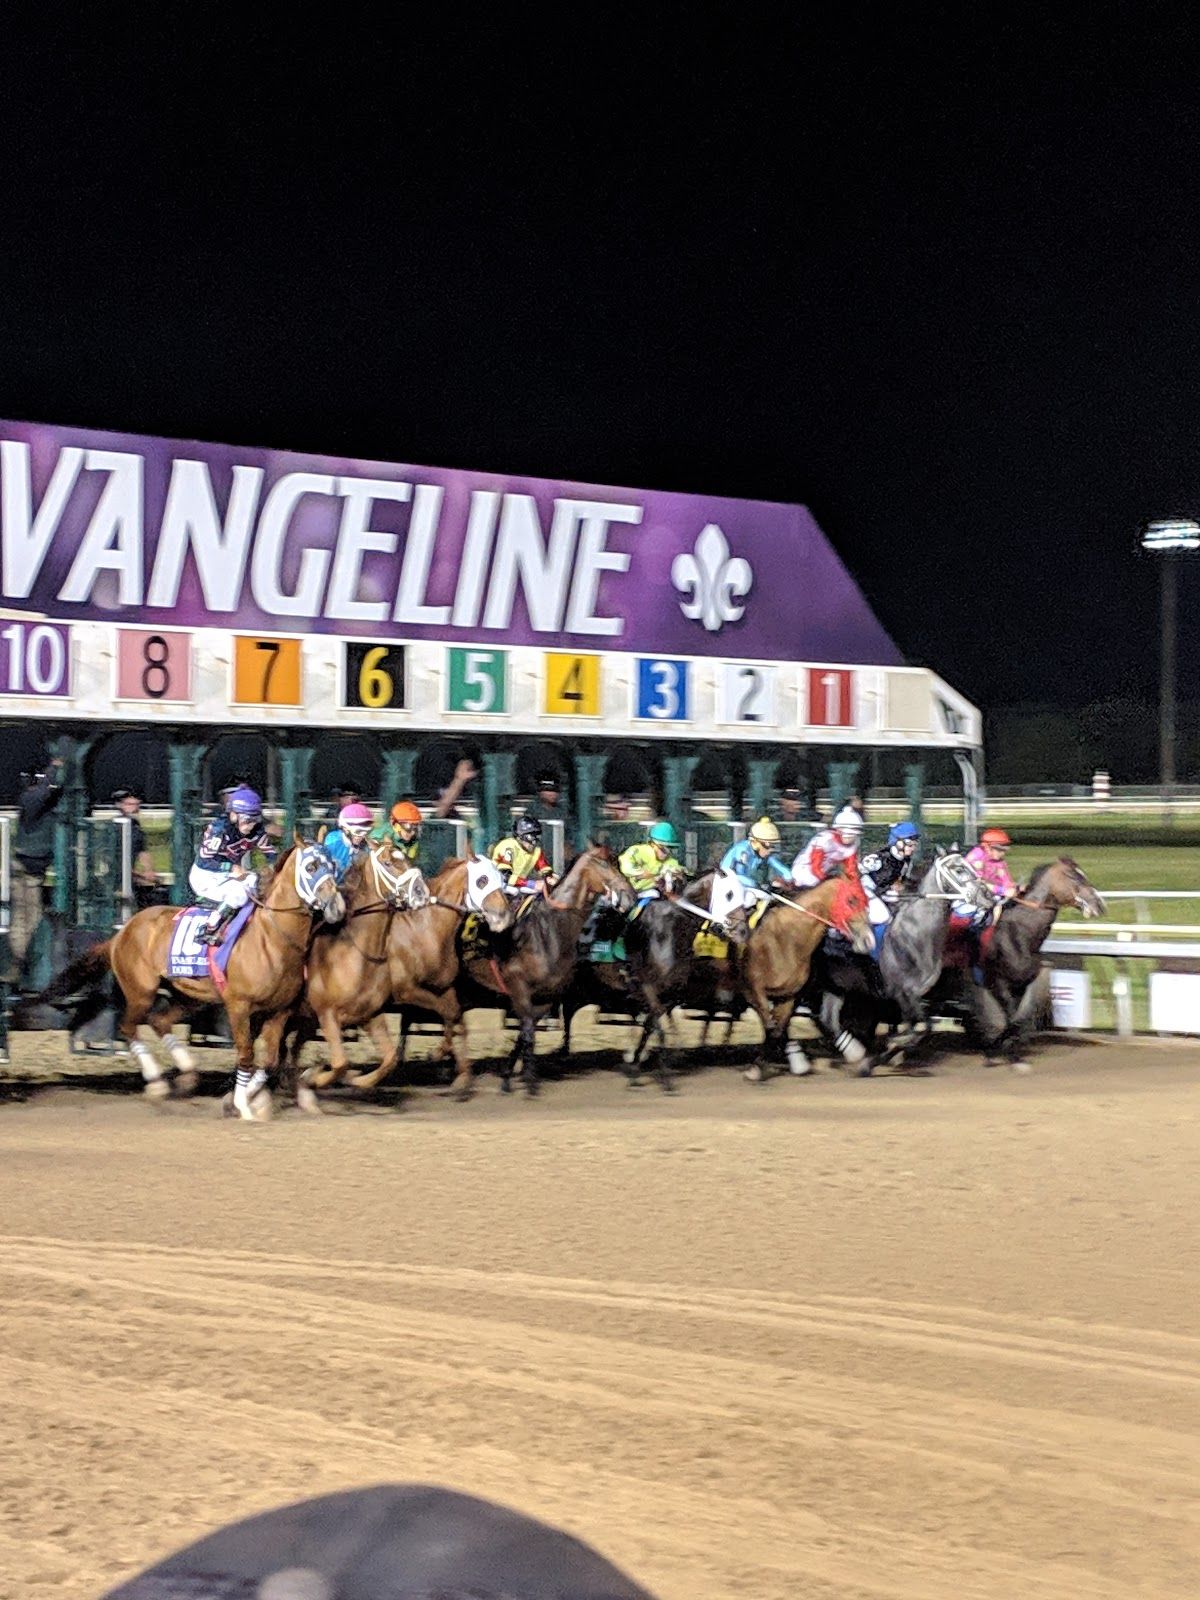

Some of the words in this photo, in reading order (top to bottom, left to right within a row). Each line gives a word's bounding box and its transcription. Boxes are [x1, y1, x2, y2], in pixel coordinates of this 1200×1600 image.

[0, 440, 643, 635] VANGELINE
[1, 624, 65, 693] 10
[142, 635, 170, 699] 8
[255, 641, 281, 702] 7
[358, 646, 394, 708] 6
[463, 653, 495, 712] 5
[559, 658, 585, 714] 4
[648, 661, 680, 719] 3
[737, 669, 764, 722] 2
[820, 672, 840, 724] 1
